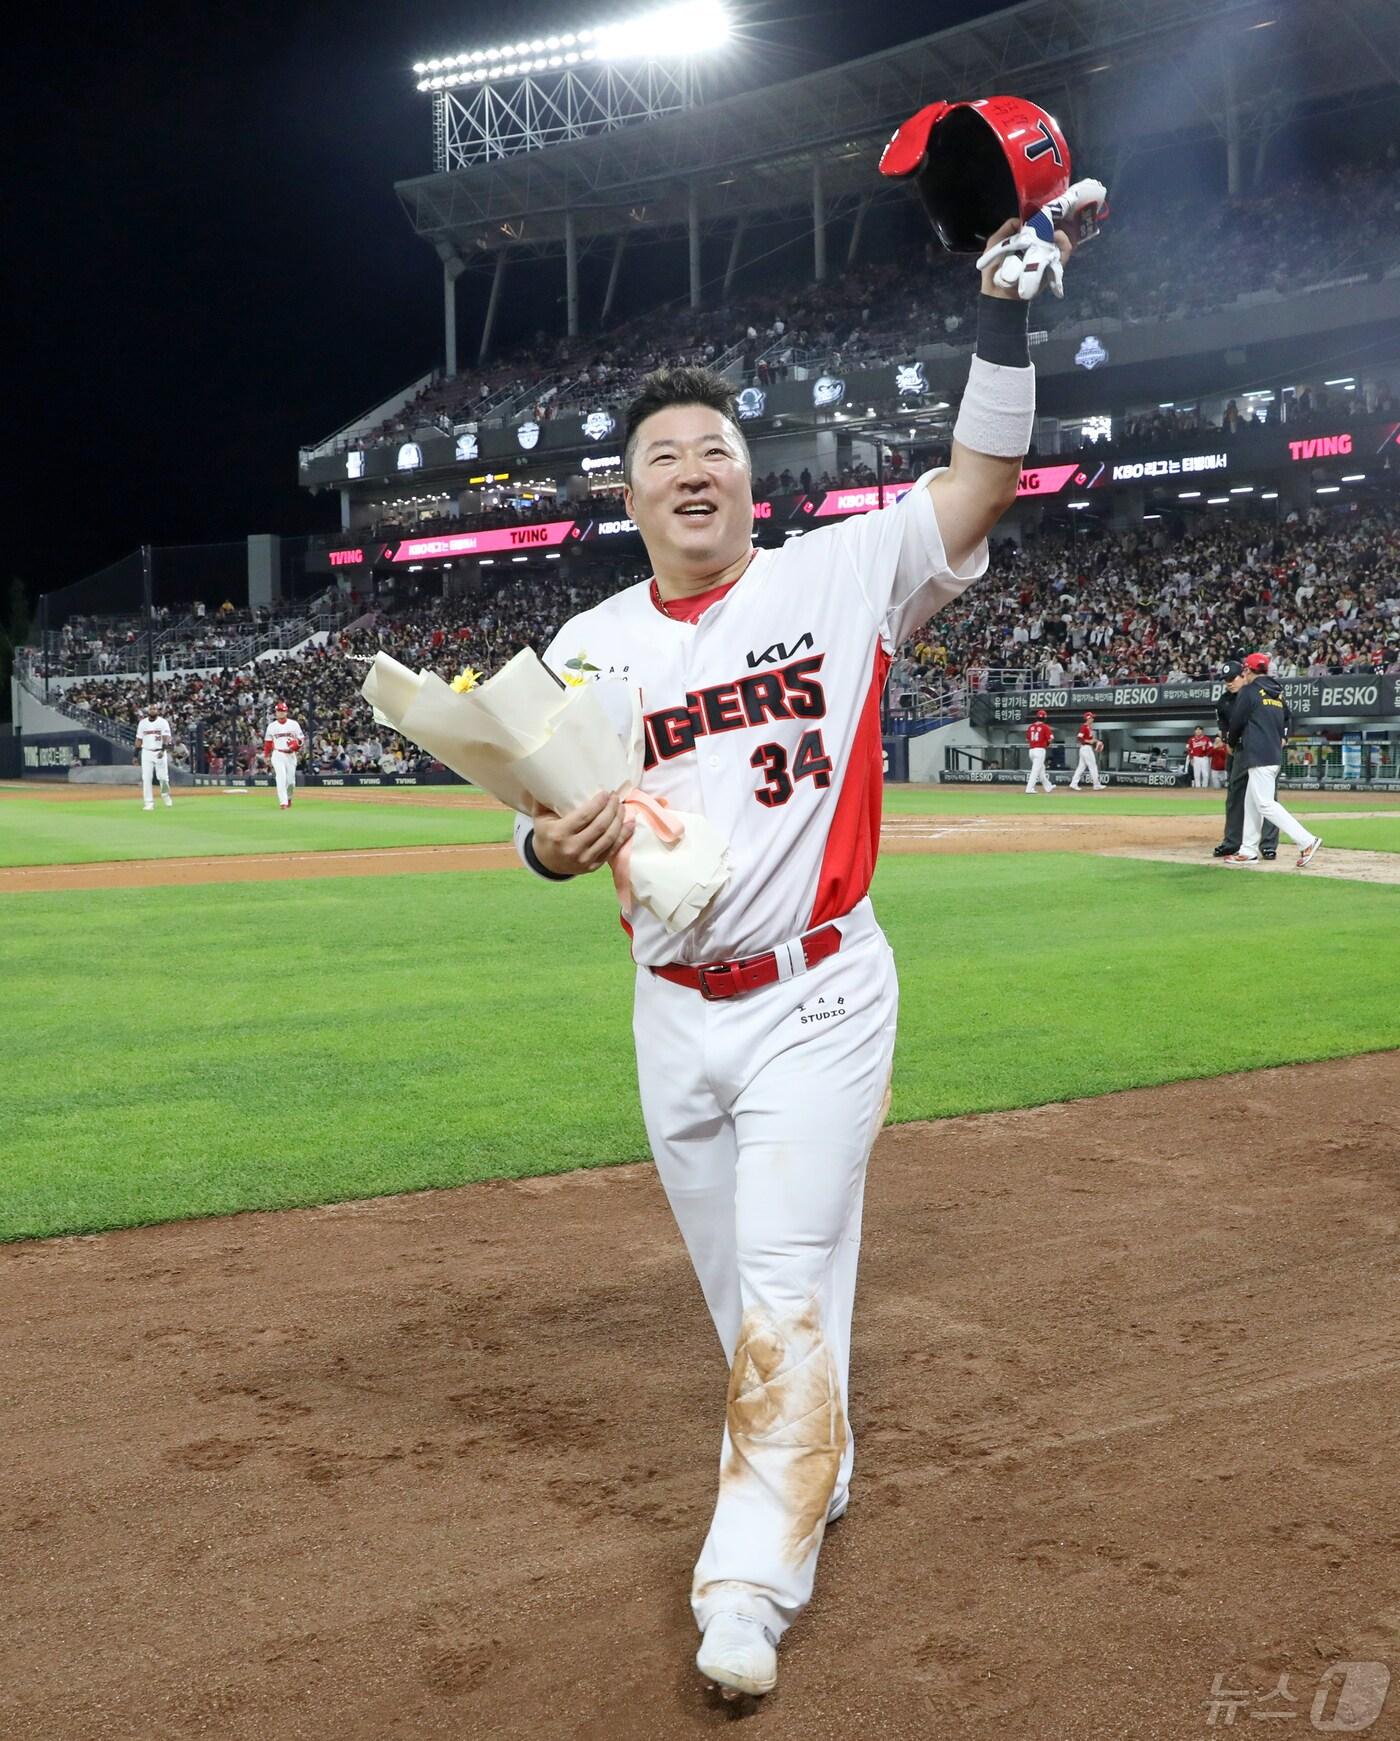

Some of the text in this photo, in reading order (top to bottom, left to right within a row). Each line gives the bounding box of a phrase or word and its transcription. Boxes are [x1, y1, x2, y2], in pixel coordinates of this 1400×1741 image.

[1024, 118, 1063, 167] T
[1288, 434, 1352, 460] TVING
[1113, 464, 1143, 480] KBO
[1144, 460, 1181, 477] 리그는
[838, 494, 865, 508] KBO
[510, 528, 548, 545] TVING
[598, 521, 621, 535] KBO
[329, 549, 363, 566] TVING
[1029, 691, 1068, 708] BESKO
[1114, 687, 1158, 705] BESKO
[1321, 686, 1378, 706] BESKO
[751, 728, 833, 807] 34
[970, 772, 993, 782] BESKO
[1148, 775, 1176, 786] BESKO
[800, 1008, 846, 1024] STUDIO
